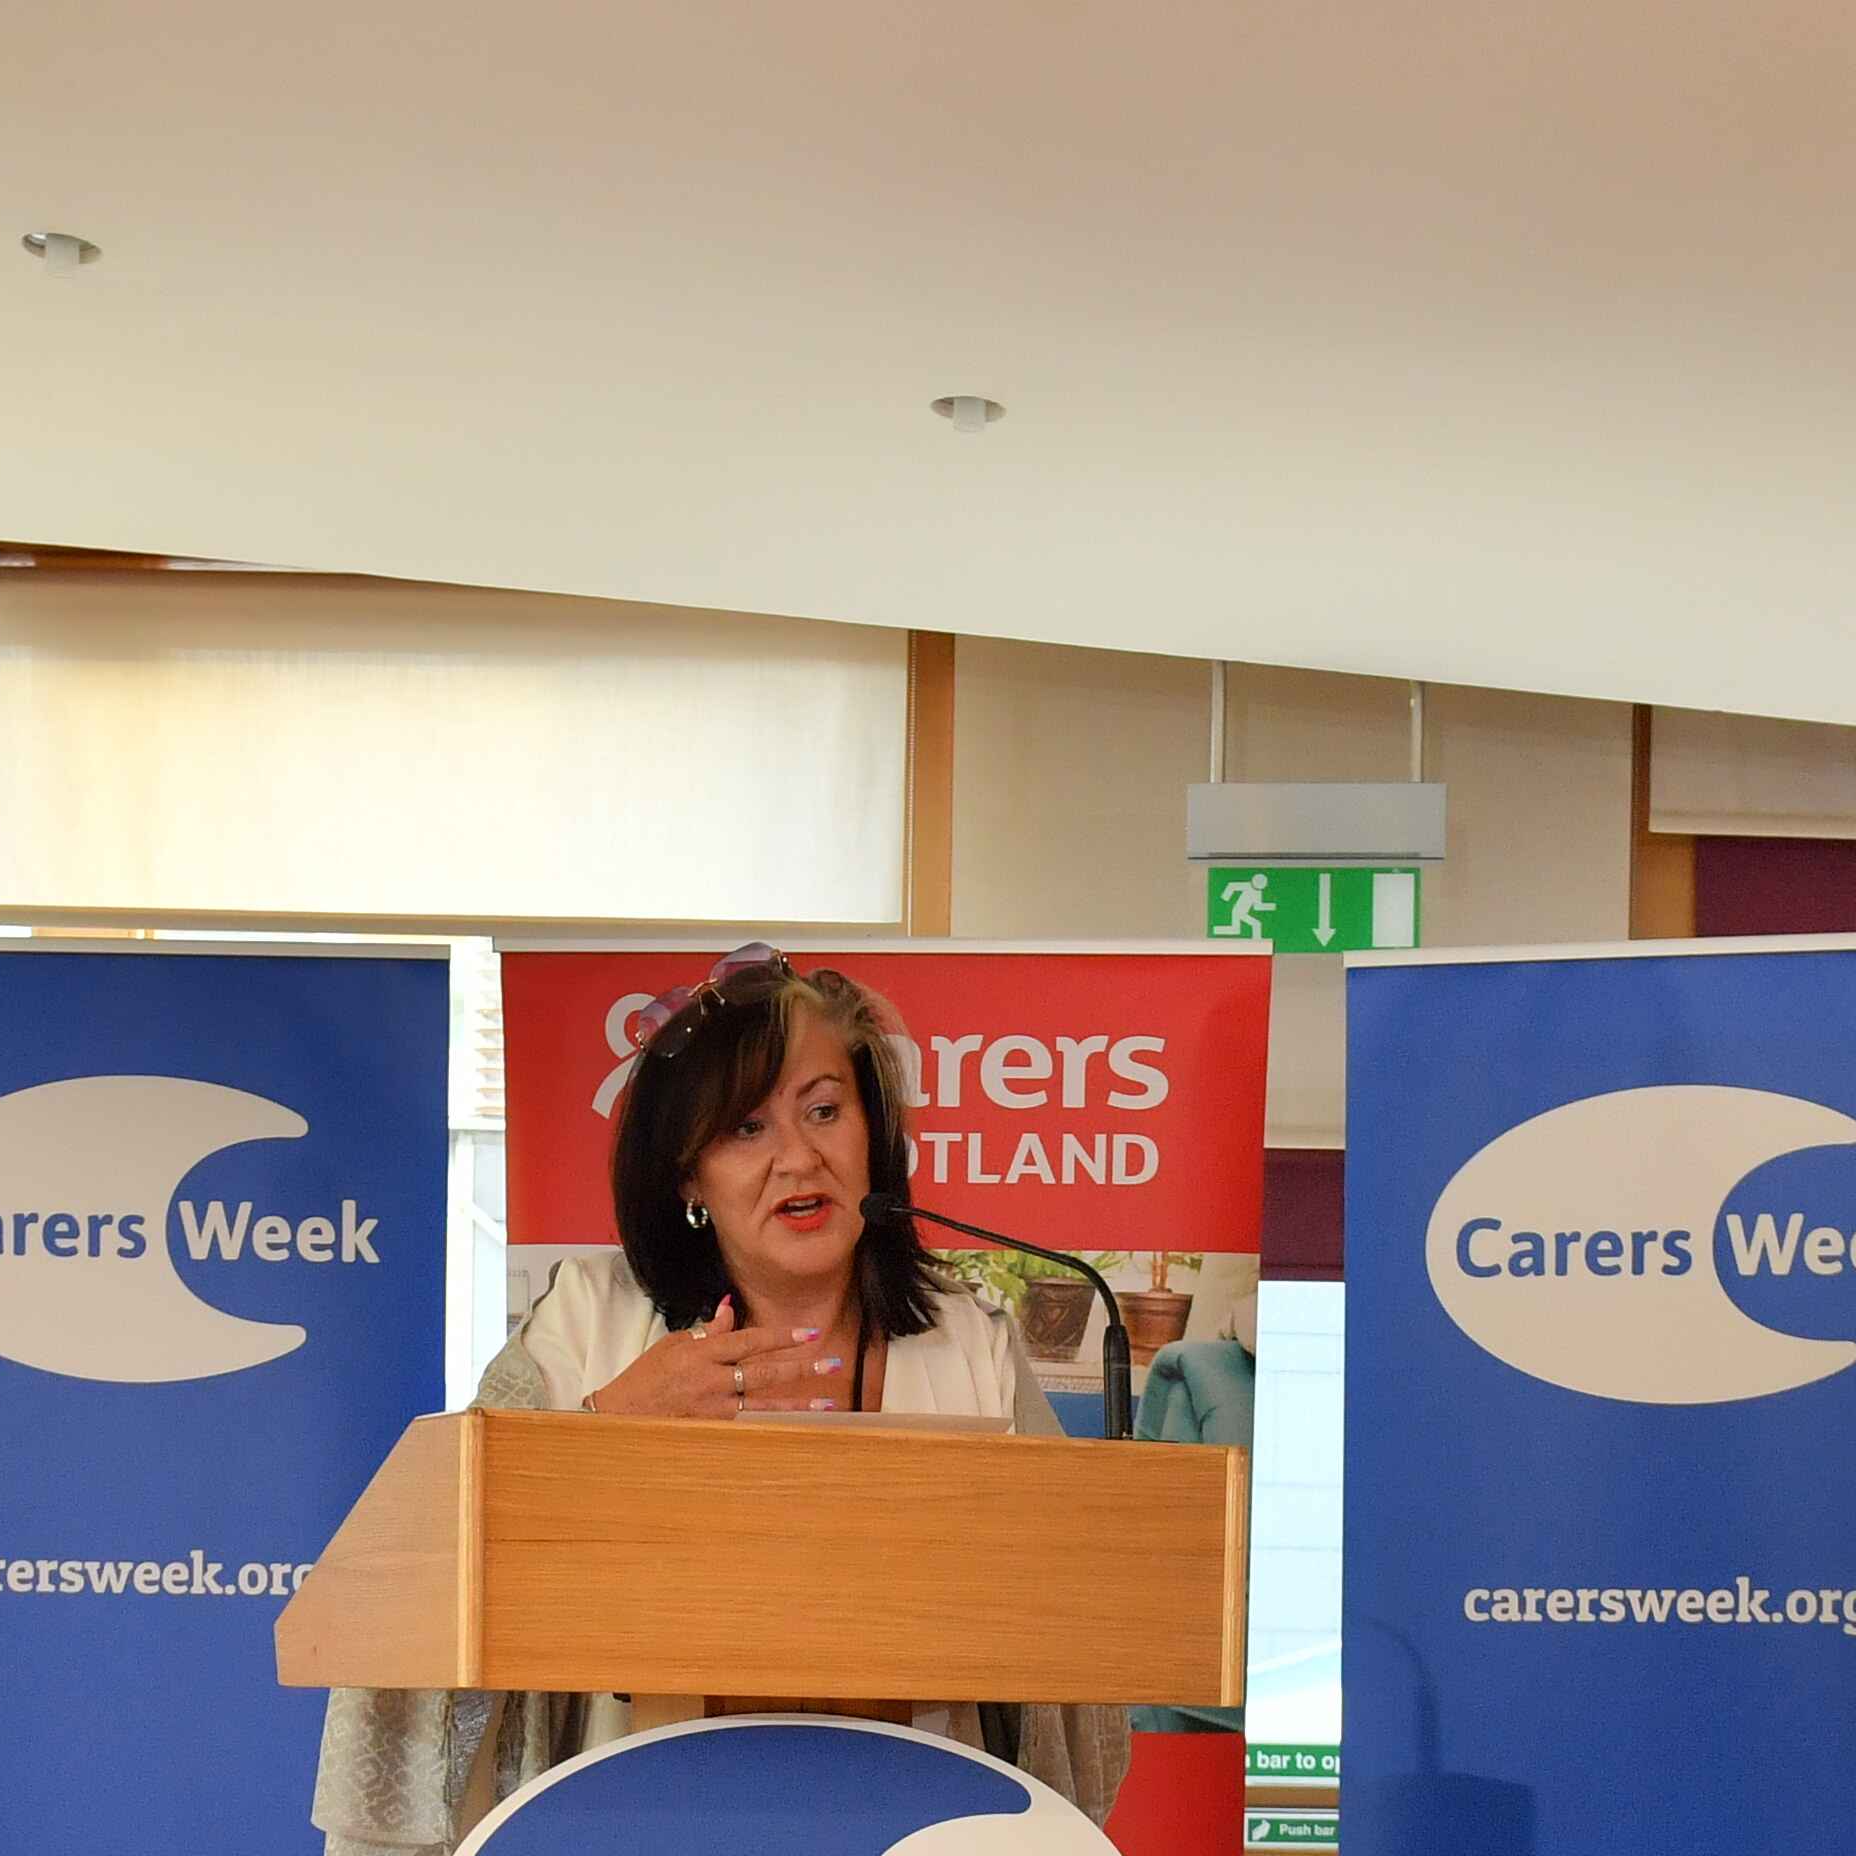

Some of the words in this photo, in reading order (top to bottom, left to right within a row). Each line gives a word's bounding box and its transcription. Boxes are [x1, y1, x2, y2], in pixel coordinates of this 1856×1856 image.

[886, 1030, 1169, 1110] arers
[907, 1131, 1159, 1186] TLAND
[179, 1200, 379, 1263] Week
[1456, 1218, 1692, 1278] Carers
[1257, 1750, 1291, 1769] bar
[1296, 1752, 1316, 1769] to
[1279, 1823, 1312, 1836] Push
[1314, 1823, 1336, 1837] bar
